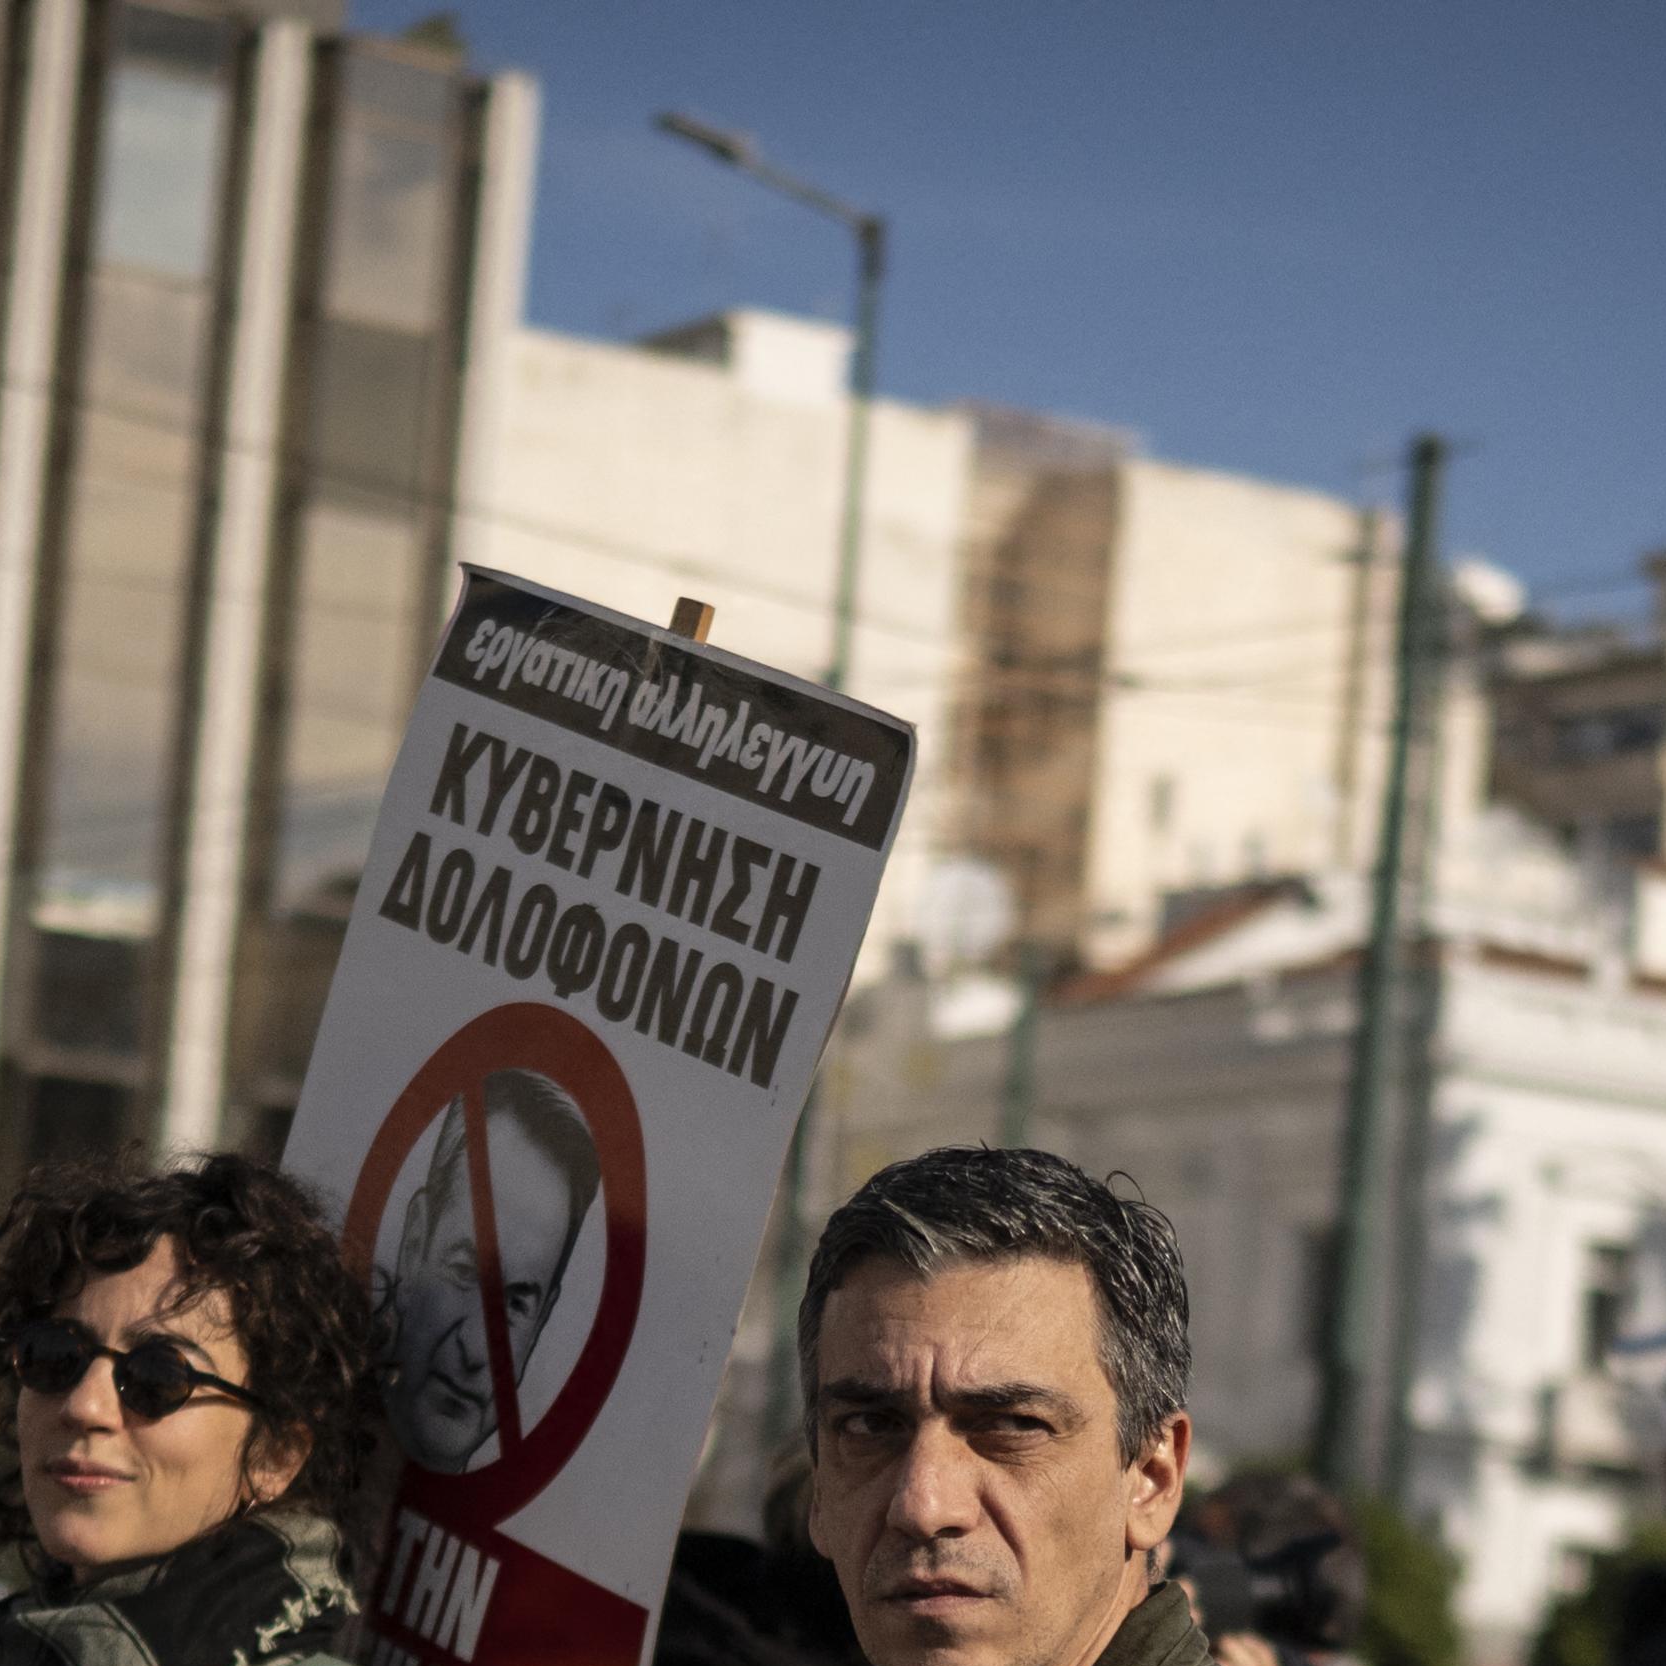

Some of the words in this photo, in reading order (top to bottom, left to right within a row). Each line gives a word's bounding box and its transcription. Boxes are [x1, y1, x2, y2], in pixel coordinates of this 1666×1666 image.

[378, 831, 799, 1090] ΔΟΛΟΦΟΝΩΝ
[428, 722, 821, 964] ΚΥΒΕΡΝΗΣΗ
[379, 1506, 501, 1663] ΤΗΝ
